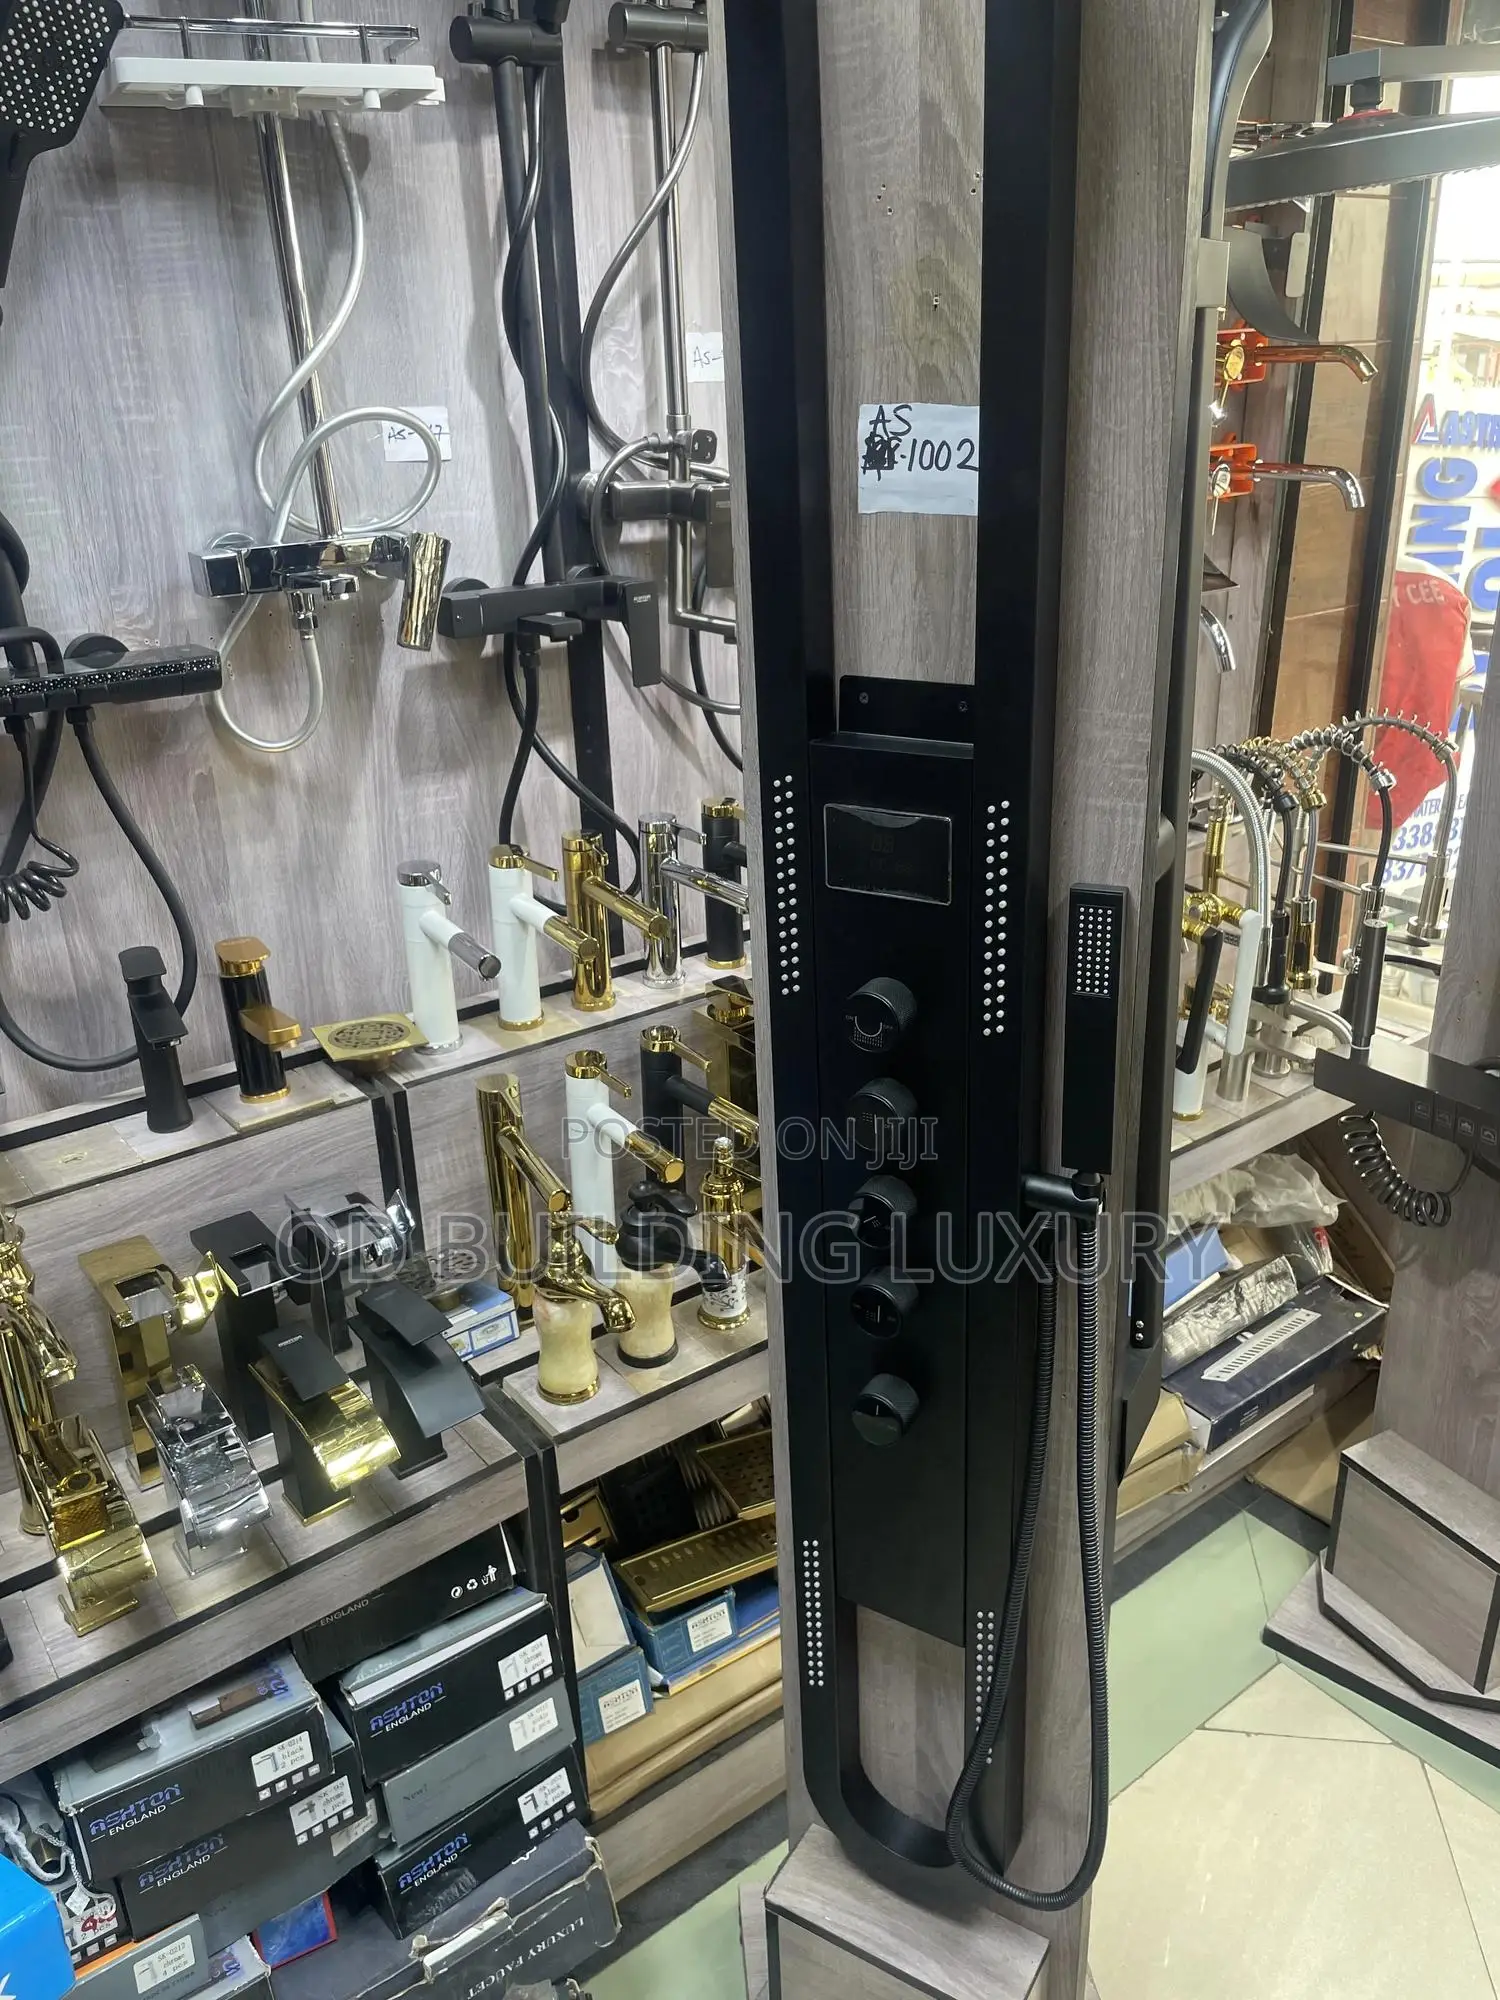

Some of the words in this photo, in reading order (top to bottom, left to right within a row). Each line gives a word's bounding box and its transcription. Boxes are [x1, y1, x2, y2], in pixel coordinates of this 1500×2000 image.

[869, 404, 913, 438] AS
[320, 1599, 369, 1626] ENGLAND
[369, 1682, 443, 1731] ASHTON
[385, 1702, 432, 1732] ENGLAND
[89, 1784, 181, 1836] ASHTON
[109, 1804, 167, 1837] ENGLAND
[139, 1833, 224, 1888] ASHTON
[157, 1854, 212, 1887] ENGLAND
[399, 1833, 468, 1889] ASHTON
[414, 1852, 459, 1887] ENGLAND
[527, 1916, 585, 1961] LUXURY
[467, 1956, 524, 2000] FAUCET
